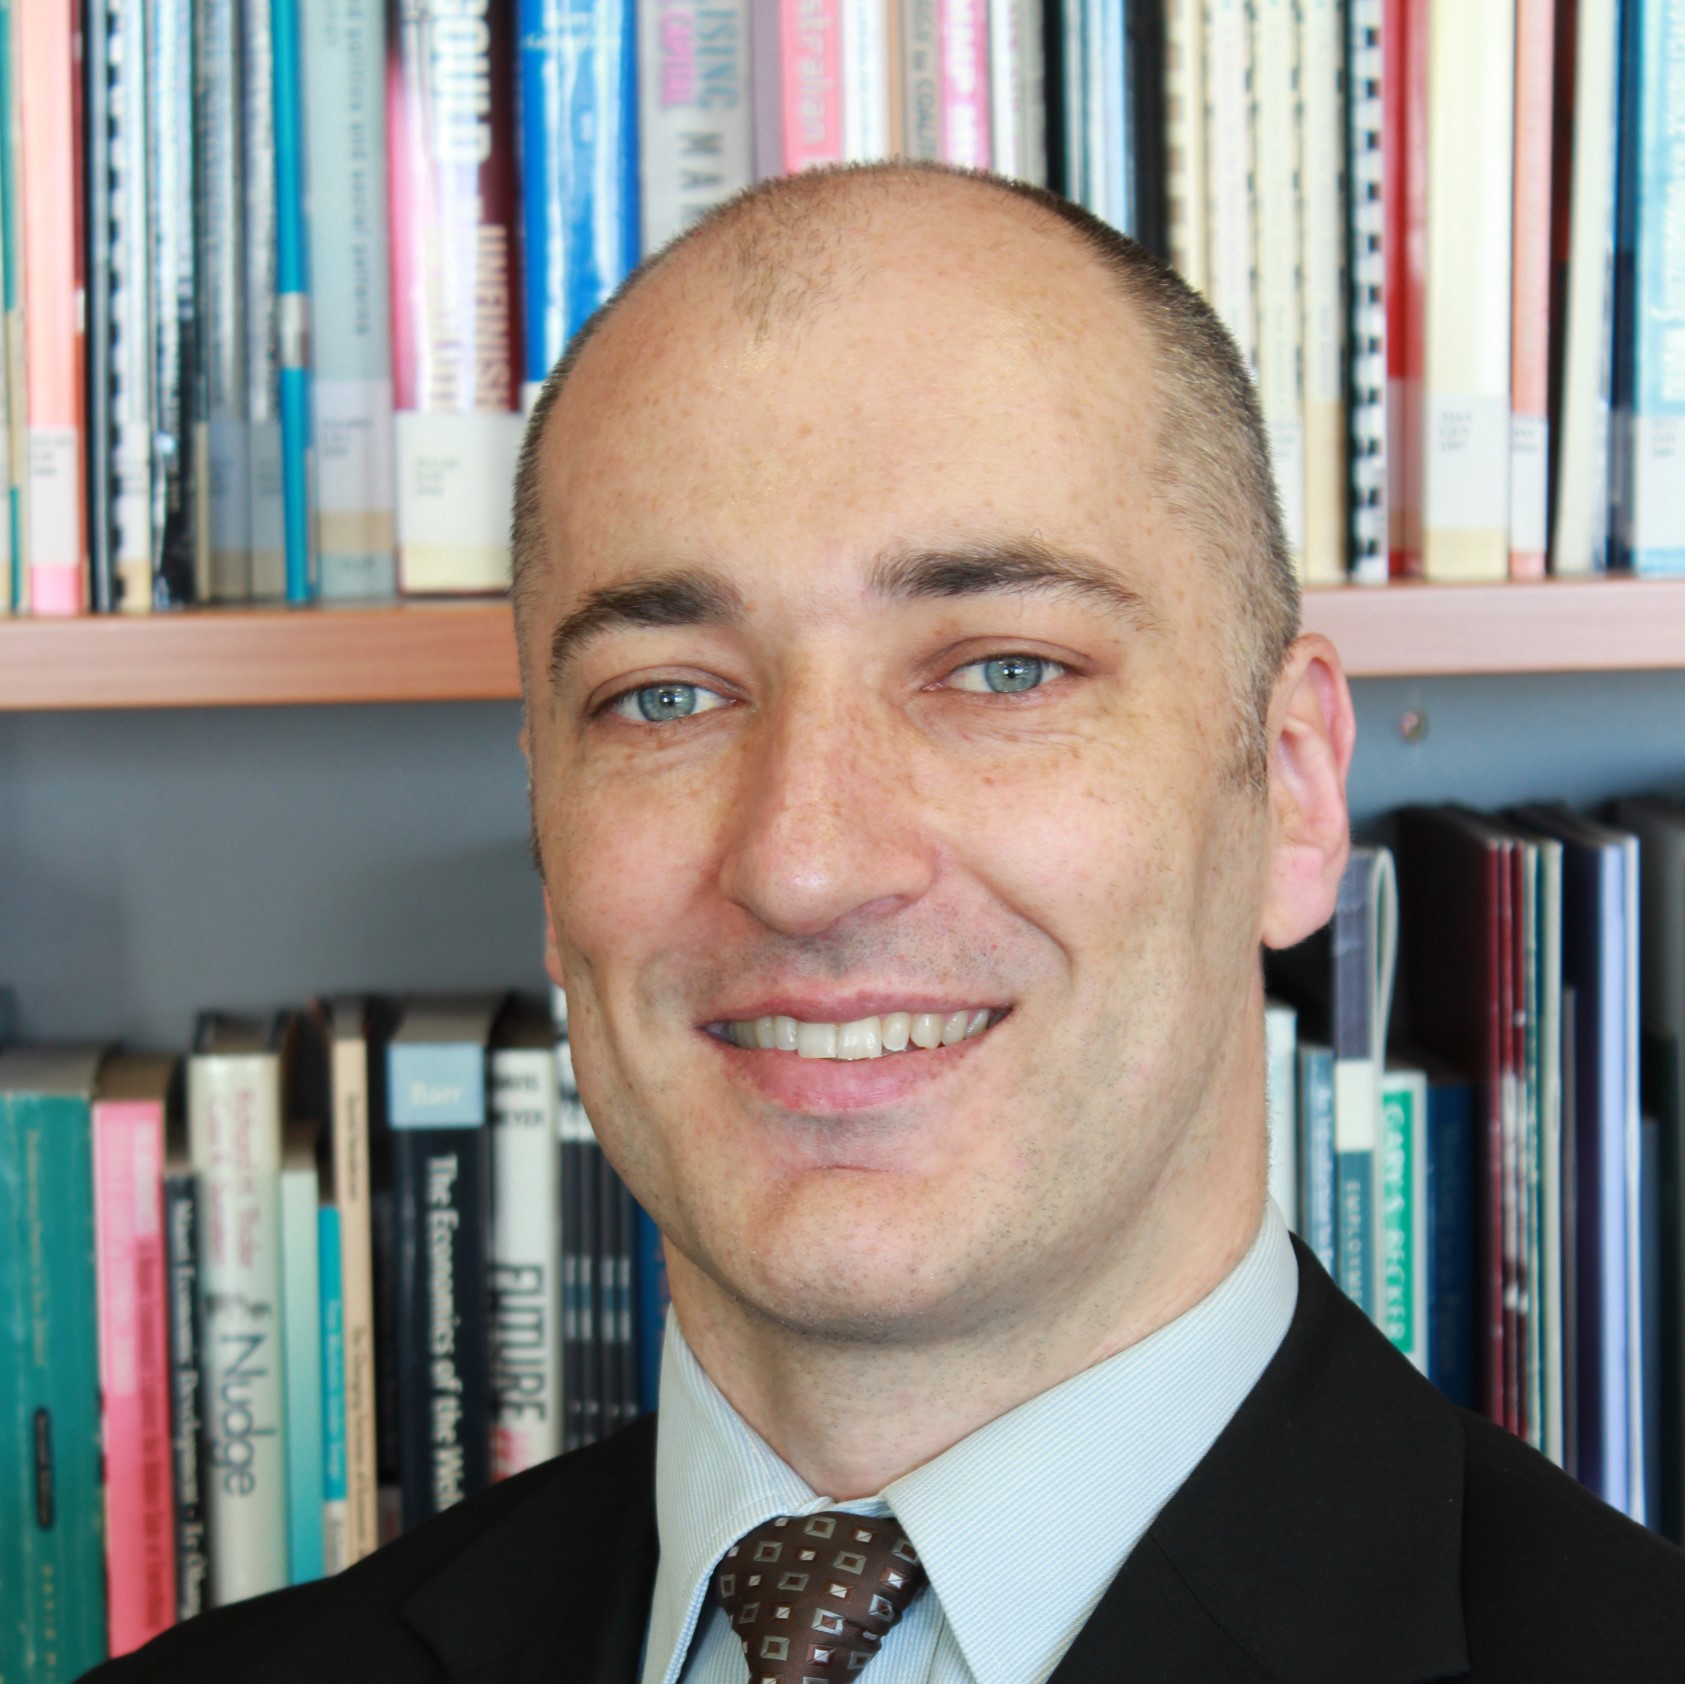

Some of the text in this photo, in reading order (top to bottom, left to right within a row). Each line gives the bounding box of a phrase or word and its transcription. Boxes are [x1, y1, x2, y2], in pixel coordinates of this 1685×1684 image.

[697, 0, 739, 111] ISING
[409, 1079, 462, 1106] Barr
[427, 1154, 459, 1205] The
[427, 1208, 461, 1354] Economics
[1384, 1228, 1406, 1341] BECKER
[433, 1357, 464, 1394] of
[488, 1263, 547, 1423] FUTURE
[207, 1333, 278, 1498] Nudge
[434, 1396, 464, 1443] the
